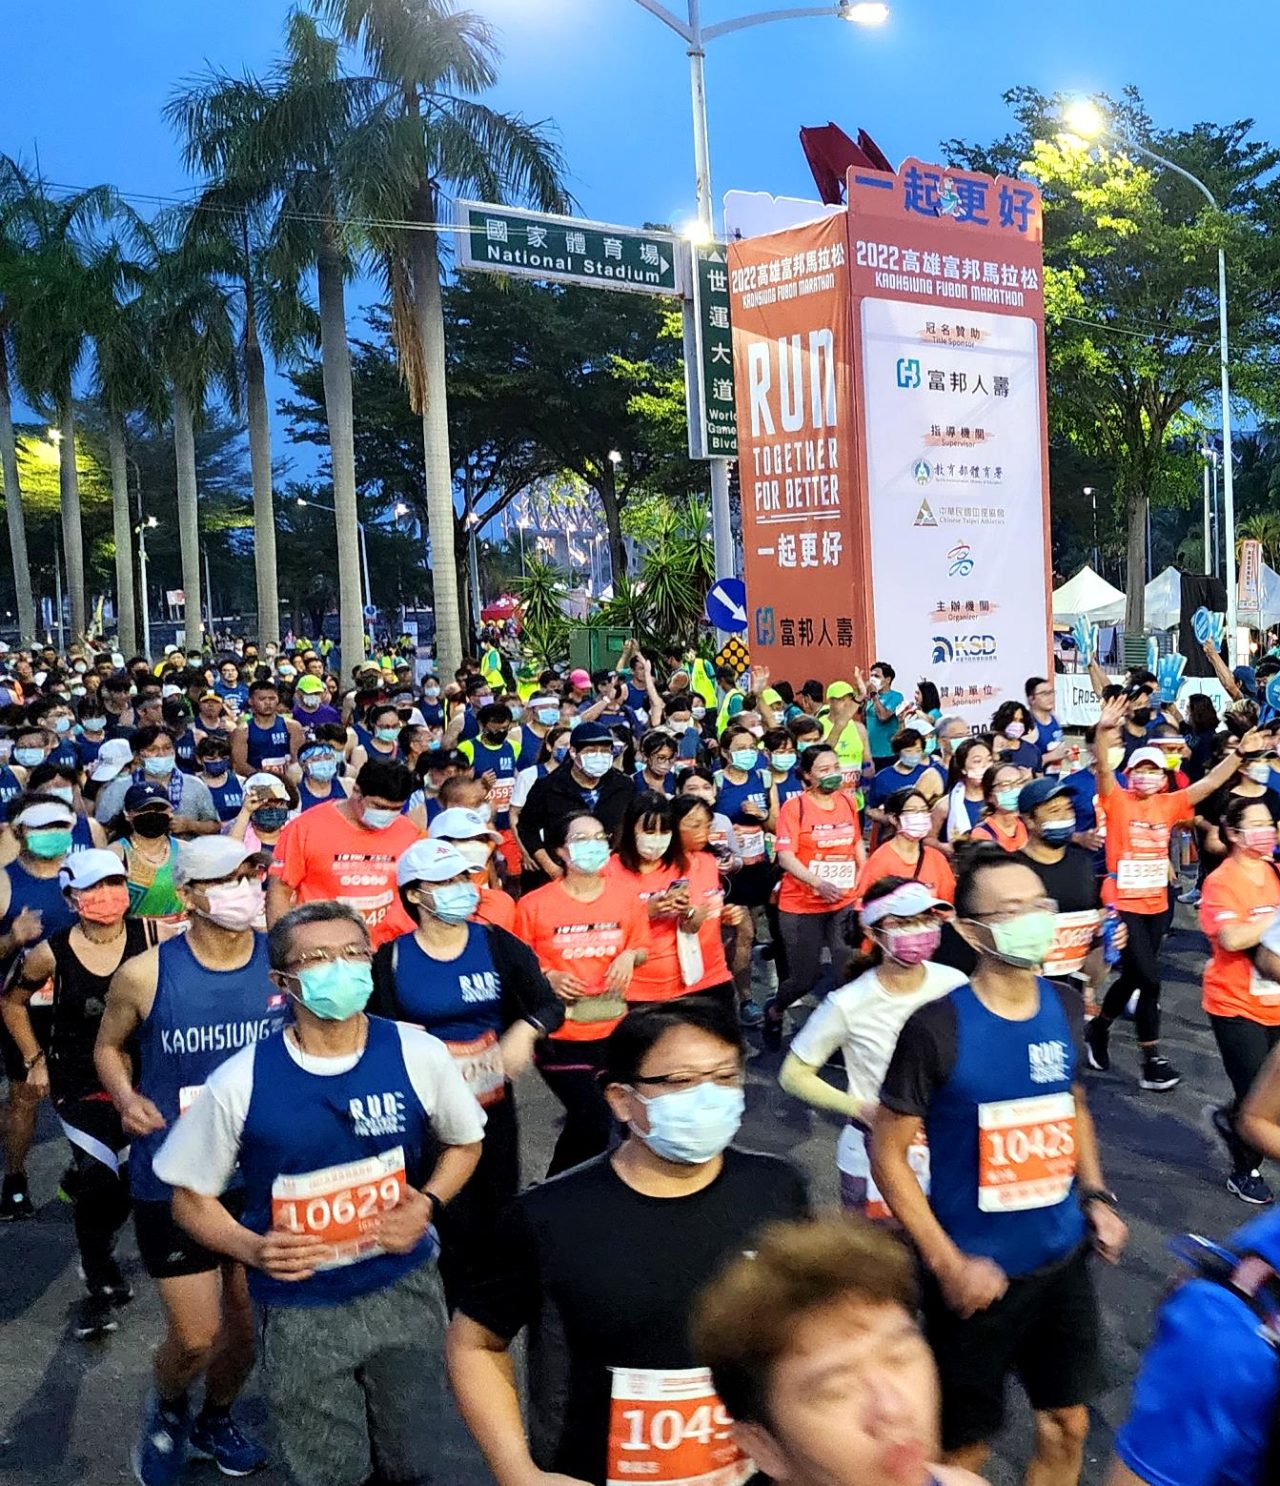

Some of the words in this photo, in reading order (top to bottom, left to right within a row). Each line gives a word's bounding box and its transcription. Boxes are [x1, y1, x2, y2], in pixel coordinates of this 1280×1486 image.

[855, 166, 1036, 232] 一起更好
[486, 218, 660, 266] 國家體育場
[487, 245, 572, 271] National
[583, 259, 660, 284] Stadium
[777, 281, 798, 301] FUBON
[799, 272, 835, 296] MARATHON
[875, 271, 932, 295] KAOHSIUNG
[936, 278, 968, 300] FUBON
[971, 284, 1024, 307] MARATHON
[706, 268, 734, 401] 世運大道
[747, 327, 837, 437] RUN
[928, 369, 1010, 398] 富邦人壽
[712, 437, 736, 449] Blvd
[931, 424, 985, 440] 指導機關
[941, 439, 975, 448] Supervisor
[753, 437, 838, 477] TOGETHER
[755, 480, 780, 511] FOR
[785, 474, 840, 508] BETTER
[757, 531, 842, 568] 一起更好
[936, 600, 990, 613] 主辦機關
[948, 613, 979, 623] Organizer
[780, 617, 853, 648] 富邦人壽
[955, 635, 997, 656] KSD
[161, 1018, 270, 1054] KAOHSIUNG
[281, 1177, 400, 1233] 10629
